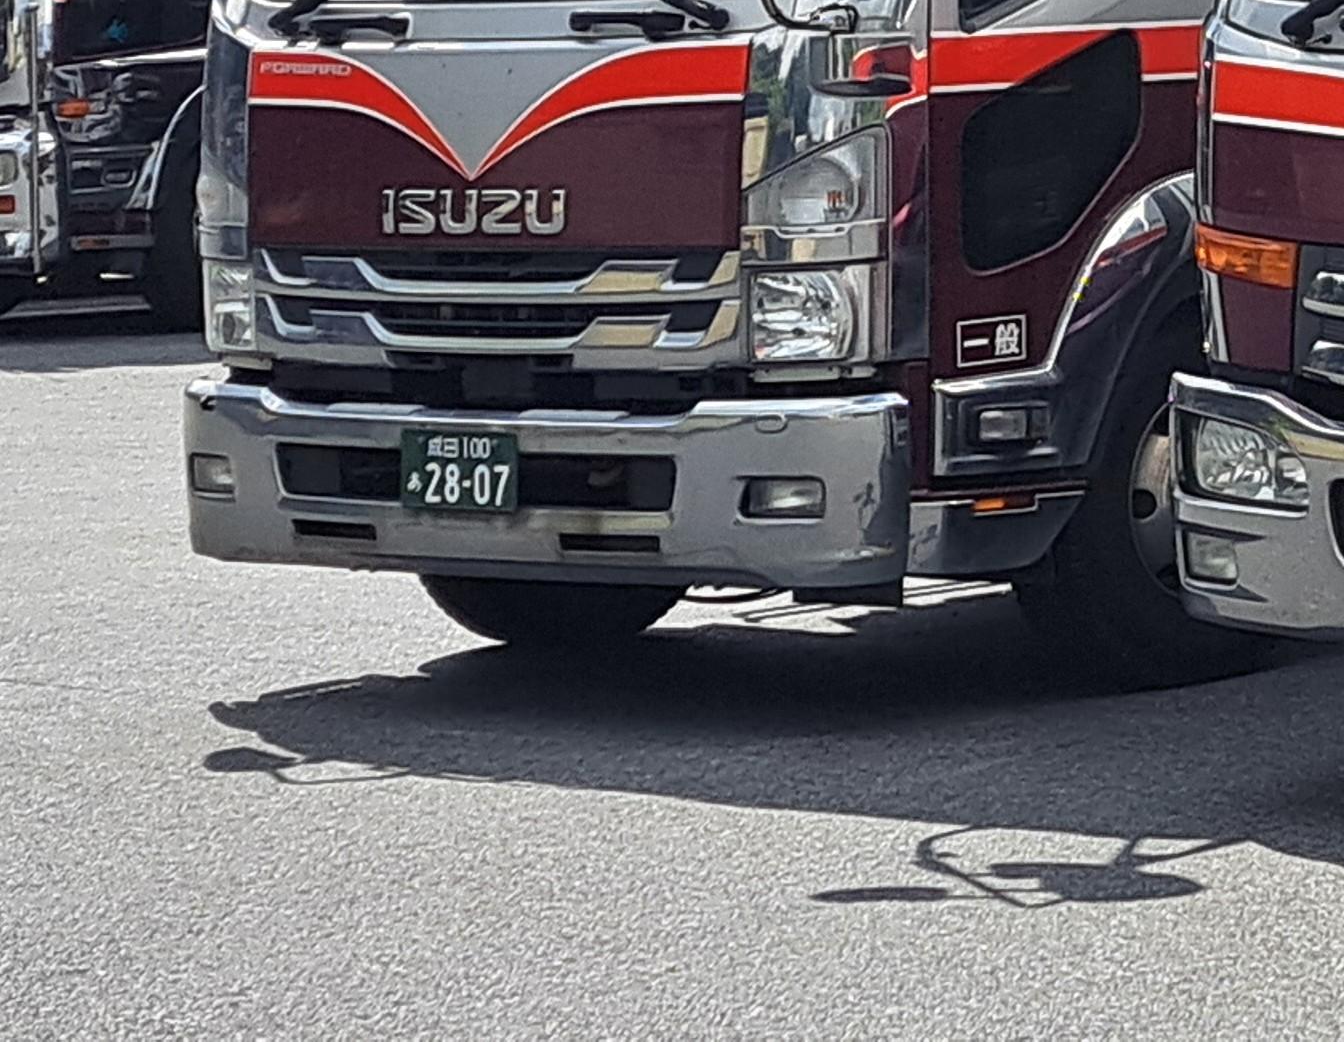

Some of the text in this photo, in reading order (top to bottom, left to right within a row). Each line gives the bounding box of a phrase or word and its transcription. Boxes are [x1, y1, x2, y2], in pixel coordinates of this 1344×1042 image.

[260, 61, 352, 76] FORWARD
[381, 188, 566, 235] ISUZU
[963, 322, 1020, 356] 一般
[424, 461, 510, 507] 28-07
